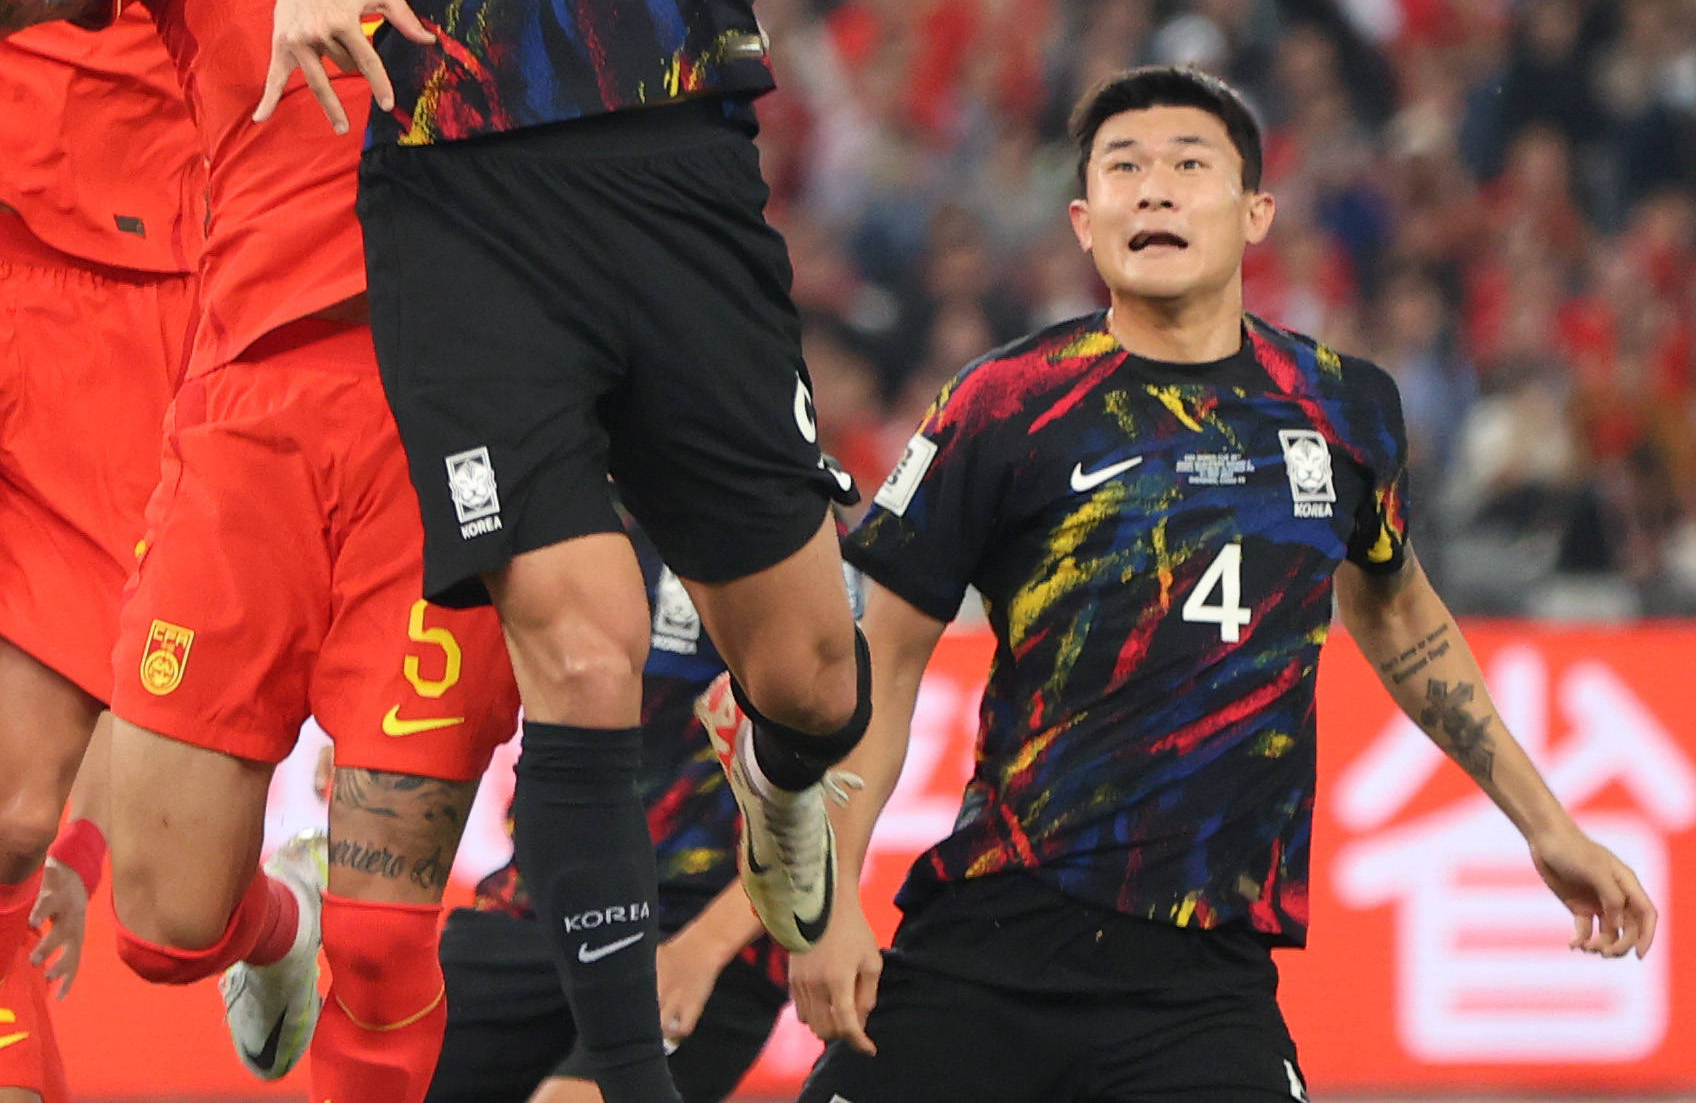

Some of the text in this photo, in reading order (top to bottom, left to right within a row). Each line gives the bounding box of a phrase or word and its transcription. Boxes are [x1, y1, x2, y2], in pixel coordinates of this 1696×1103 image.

[460, 515, 503, 540] KOREA
[1182, 543, 1252, 643] 4
[404, 598, 462, 698] 5
[564, 901, 650, 934] KOREA
